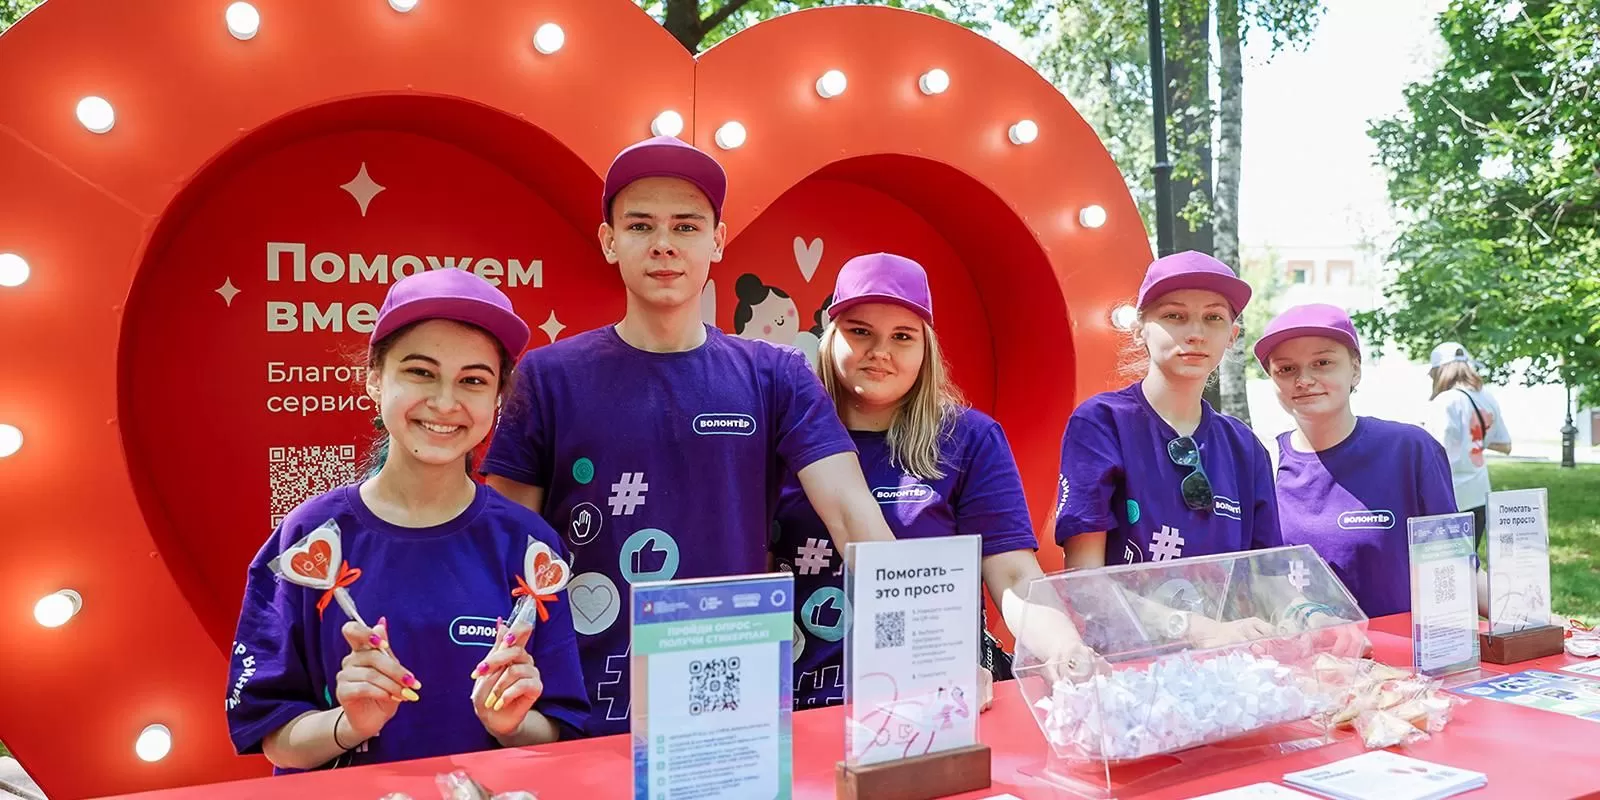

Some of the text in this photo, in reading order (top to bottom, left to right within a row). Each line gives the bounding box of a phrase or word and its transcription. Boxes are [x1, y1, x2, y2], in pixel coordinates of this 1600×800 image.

[700, 418, 750, 428] ВОЛОНТЁР
[876, 488, 927, 498] ВОЛОНТЁР
[1499, 504, 1532, 514] Помогать
[1512, 516, 1536, 526] просто
[876, 566, 947, 581] Помогать
[875, 583, 955, 599] это просто
